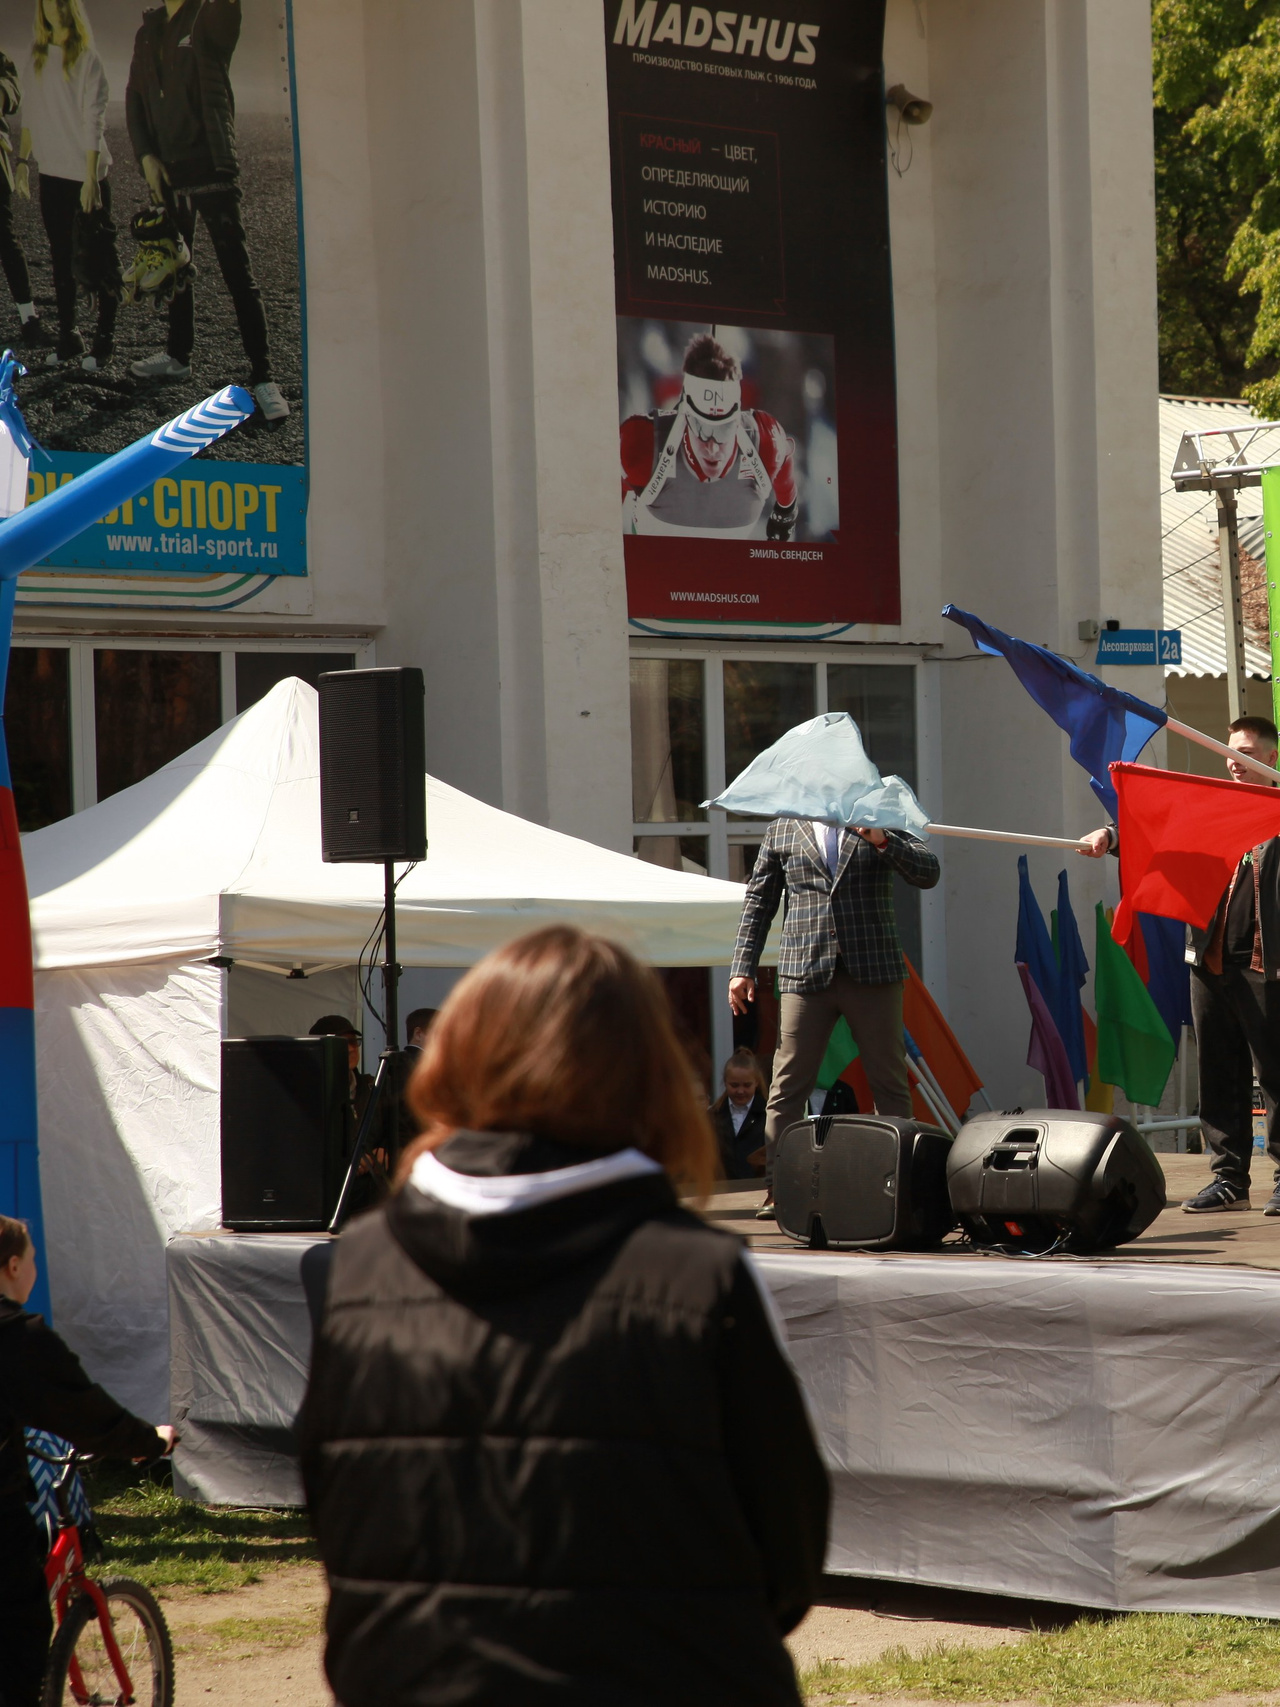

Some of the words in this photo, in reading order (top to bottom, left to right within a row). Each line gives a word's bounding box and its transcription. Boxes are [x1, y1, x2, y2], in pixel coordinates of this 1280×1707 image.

[612, 0, 820, 65] MADSHUS
[633, 52, 702, 72] ПРОИЗВОДСТВО
[704, 63, 743, 79] БЕГОВЫХ
[744, 70, 766, 81] ЛЫЖ
[774, 74, 793, 86] 1906
[795, 77, 817, 89] ГОДА
[640, 132, 701, 154] КРАСНЫЙ
[725, 144, 758, 164] ЦВЕТ,
[641, 166, 750, 194] ОПРЕДЕЛЯЮЩИЙ
[643, 199, 707, 220] ИСТОРИЮ
[645, 231, 655, 246] И
[657, 233, 723, 255] НАСЛЕДИЕ
[647, 264, 712, 285] MADSHUS.
[107, 533, 278, 560] www.trial-sport.ru
[749, 548, 779, 559] ЭМИЛЬ
[780, 550, 823, 562] СВЕНДСЕН
[670, 591, 760, 604] WWW.MADSHUS.COM
[1101, 639, 1154, 656] Лесопарковая
[1161, 635, 1179, 660] 2а
